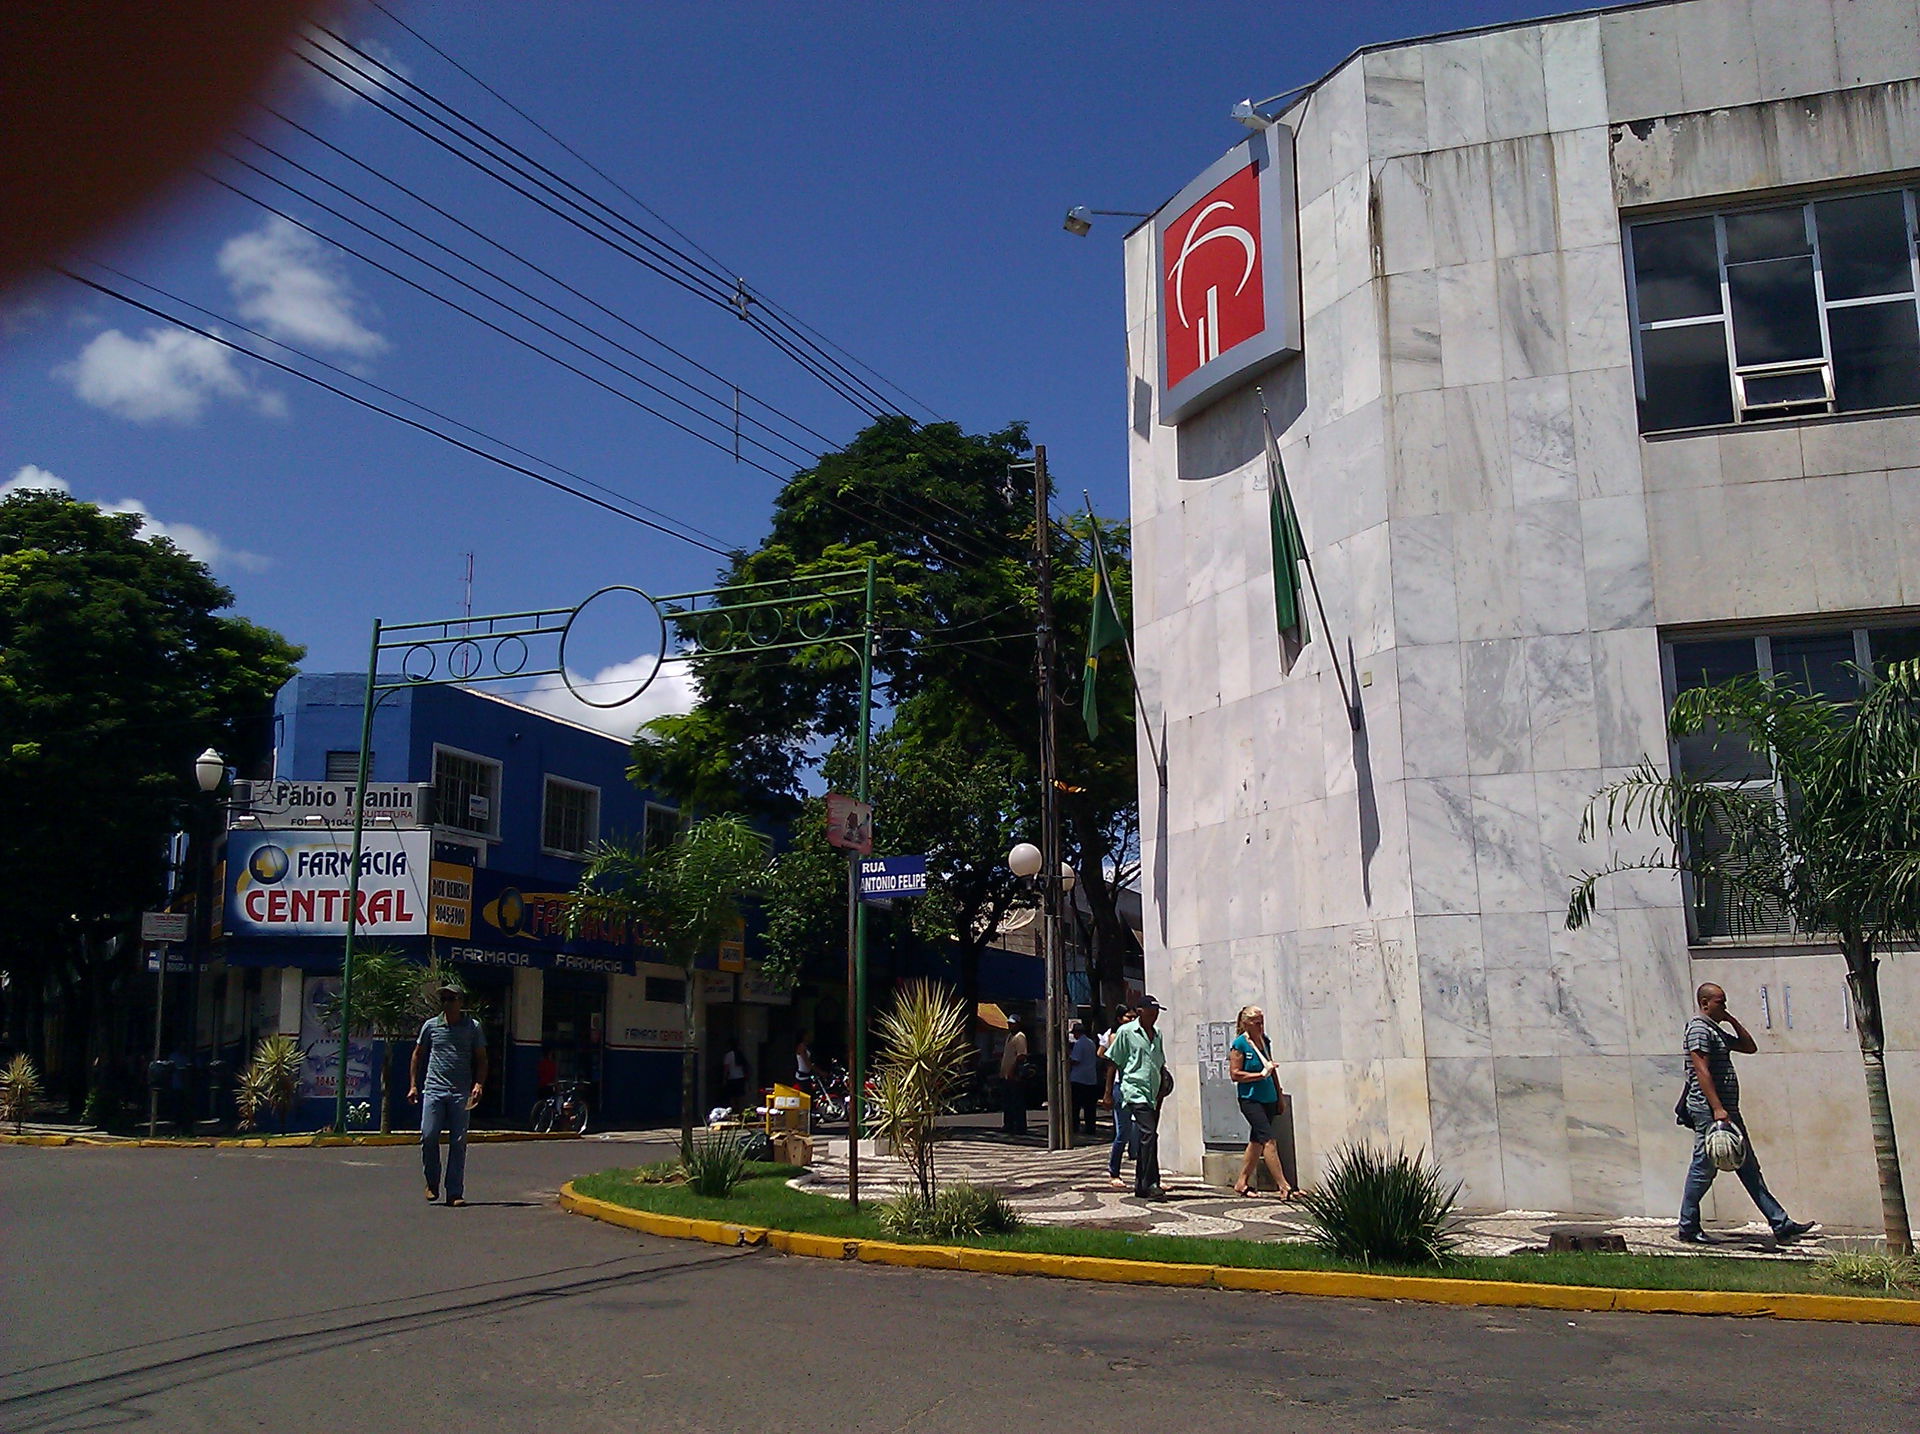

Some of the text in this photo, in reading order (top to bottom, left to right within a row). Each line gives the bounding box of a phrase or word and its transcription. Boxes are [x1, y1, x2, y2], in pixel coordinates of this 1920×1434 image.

[276, 785, 413, 807] Fábio Tanin
[298, 846, 407, 878] FARMÁCIA
[862, 861, 887, 873] RUA
[860, 873, 927, 891] ANTONIO FELIPE
[245, 889, 414, 926] CENTRAL
[450, 946, 530, 966] FARMACIA
[554, 953, 624, 973] FARMACIA
